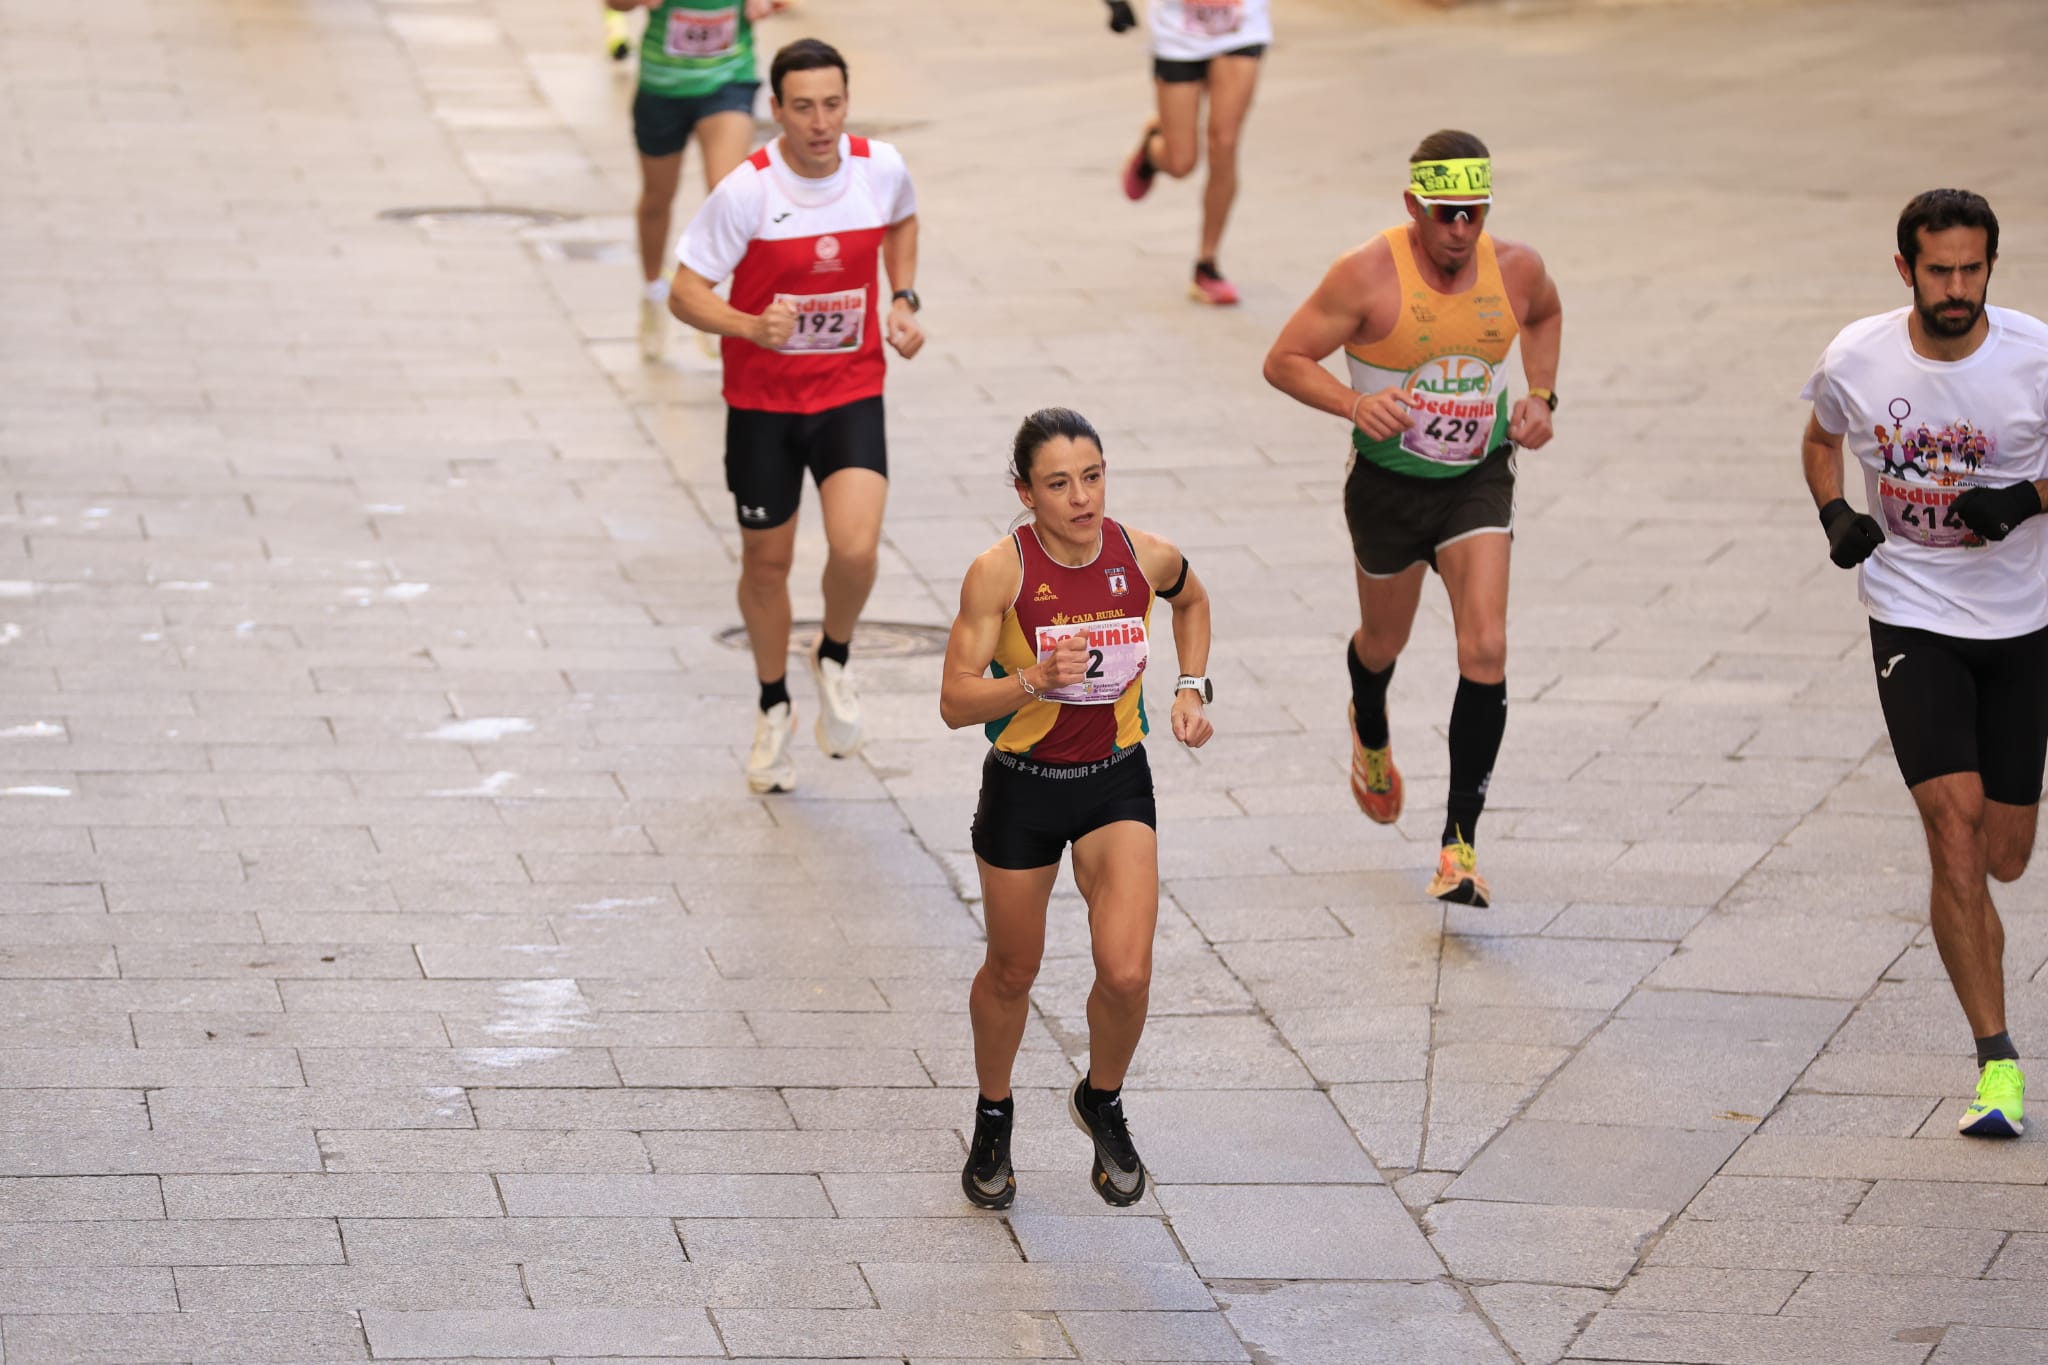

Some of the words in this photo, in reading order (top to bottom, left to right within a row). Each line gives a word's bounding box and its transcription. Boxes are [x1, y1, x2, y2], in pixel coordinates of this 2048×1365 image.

[797, 312, 844, 334] 192
[1424, 416, 1478, 443] 429
[1901, 503, 1964, 530] 414
[1072, 614, 1094, 624] CAJA
[1096, 608, 1126, 620] RURAL
[1040, 623, 1145, 652] bunia
[1085, 649, 1104, 679] 2
[1040, 765, 1089, 780] ARMOUR
